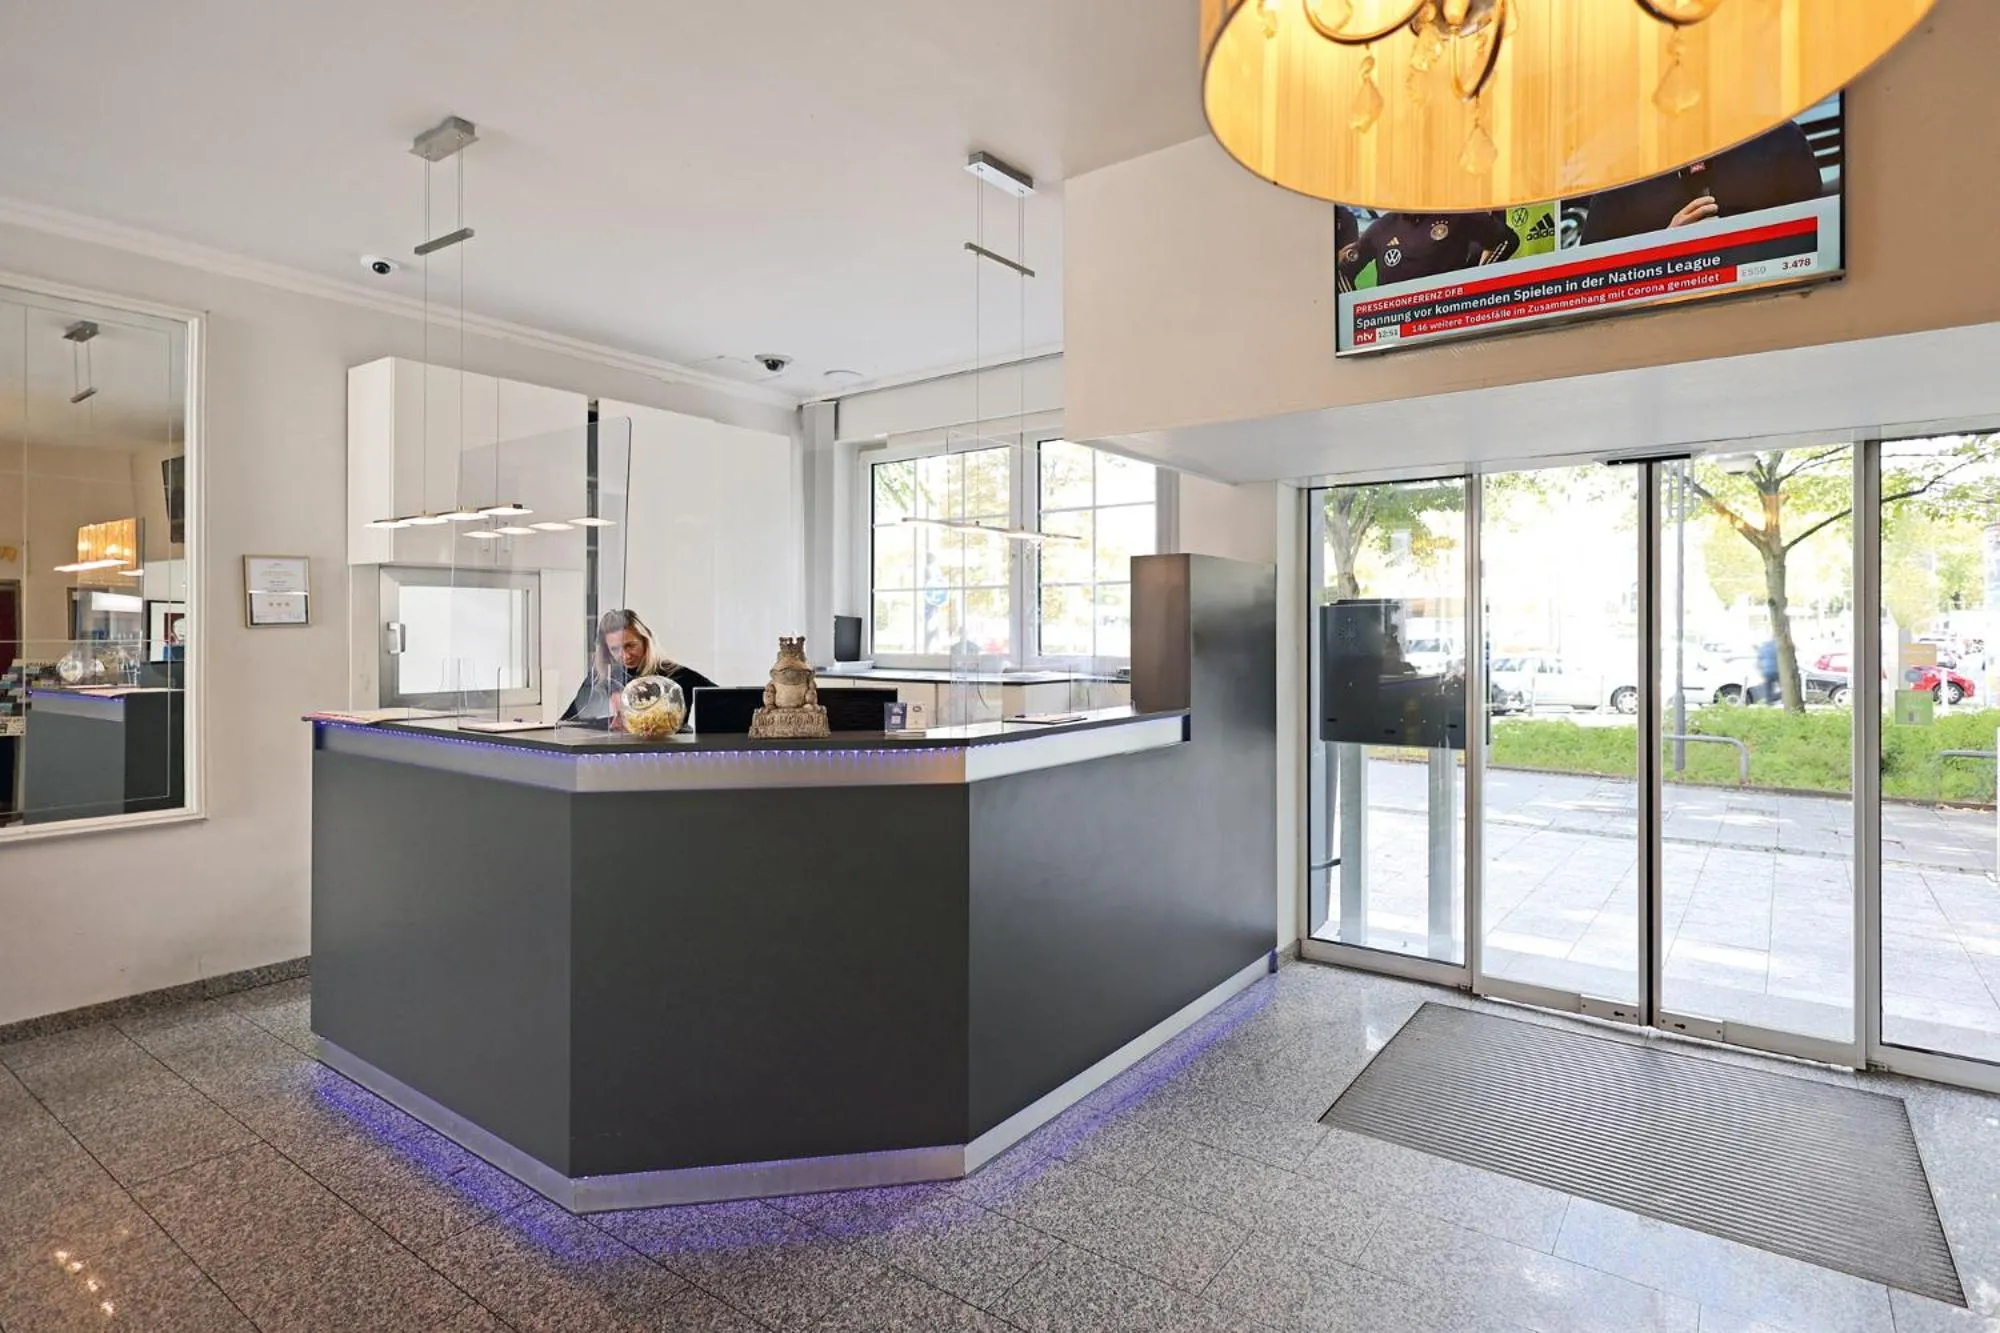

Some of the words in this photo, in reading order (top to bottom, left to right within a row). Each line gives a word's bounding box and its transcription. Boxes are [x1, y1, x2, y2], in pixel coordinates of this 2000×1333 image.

[1782, 258, 1811, 270] 3.478
[1356, 311, 1412, 330] Spannung
[1414, 308, 1432, 318] vor
[1435, 293, 1510, 314] kommenden
[1514, 284, 1561, 302] Spielen
[1566, 280, 1578, 291] in
[1582, 277, 1604, 289] der
[1608, 266, 1663, 284] Nations
[1667, 256, 1721, 274] League
[1356, 291, 1442, 313] PRESSEKONFERENZ
[1412, 324, 1428, 333] 146
[1430, 318, 1462, 330] weitere
[1465, 309, 1511, 324] Todesfälle
[1513, 307, 1526, 317] im
[1528, 294, 1606, 313] Zusammenhang
[1607, 289, 1625, 300] mit
[1627, 283, 1665, 296] Corona
[1667, 273, 1720, 291] gemeldet
[1356, 332, 1373, 342] ntv
